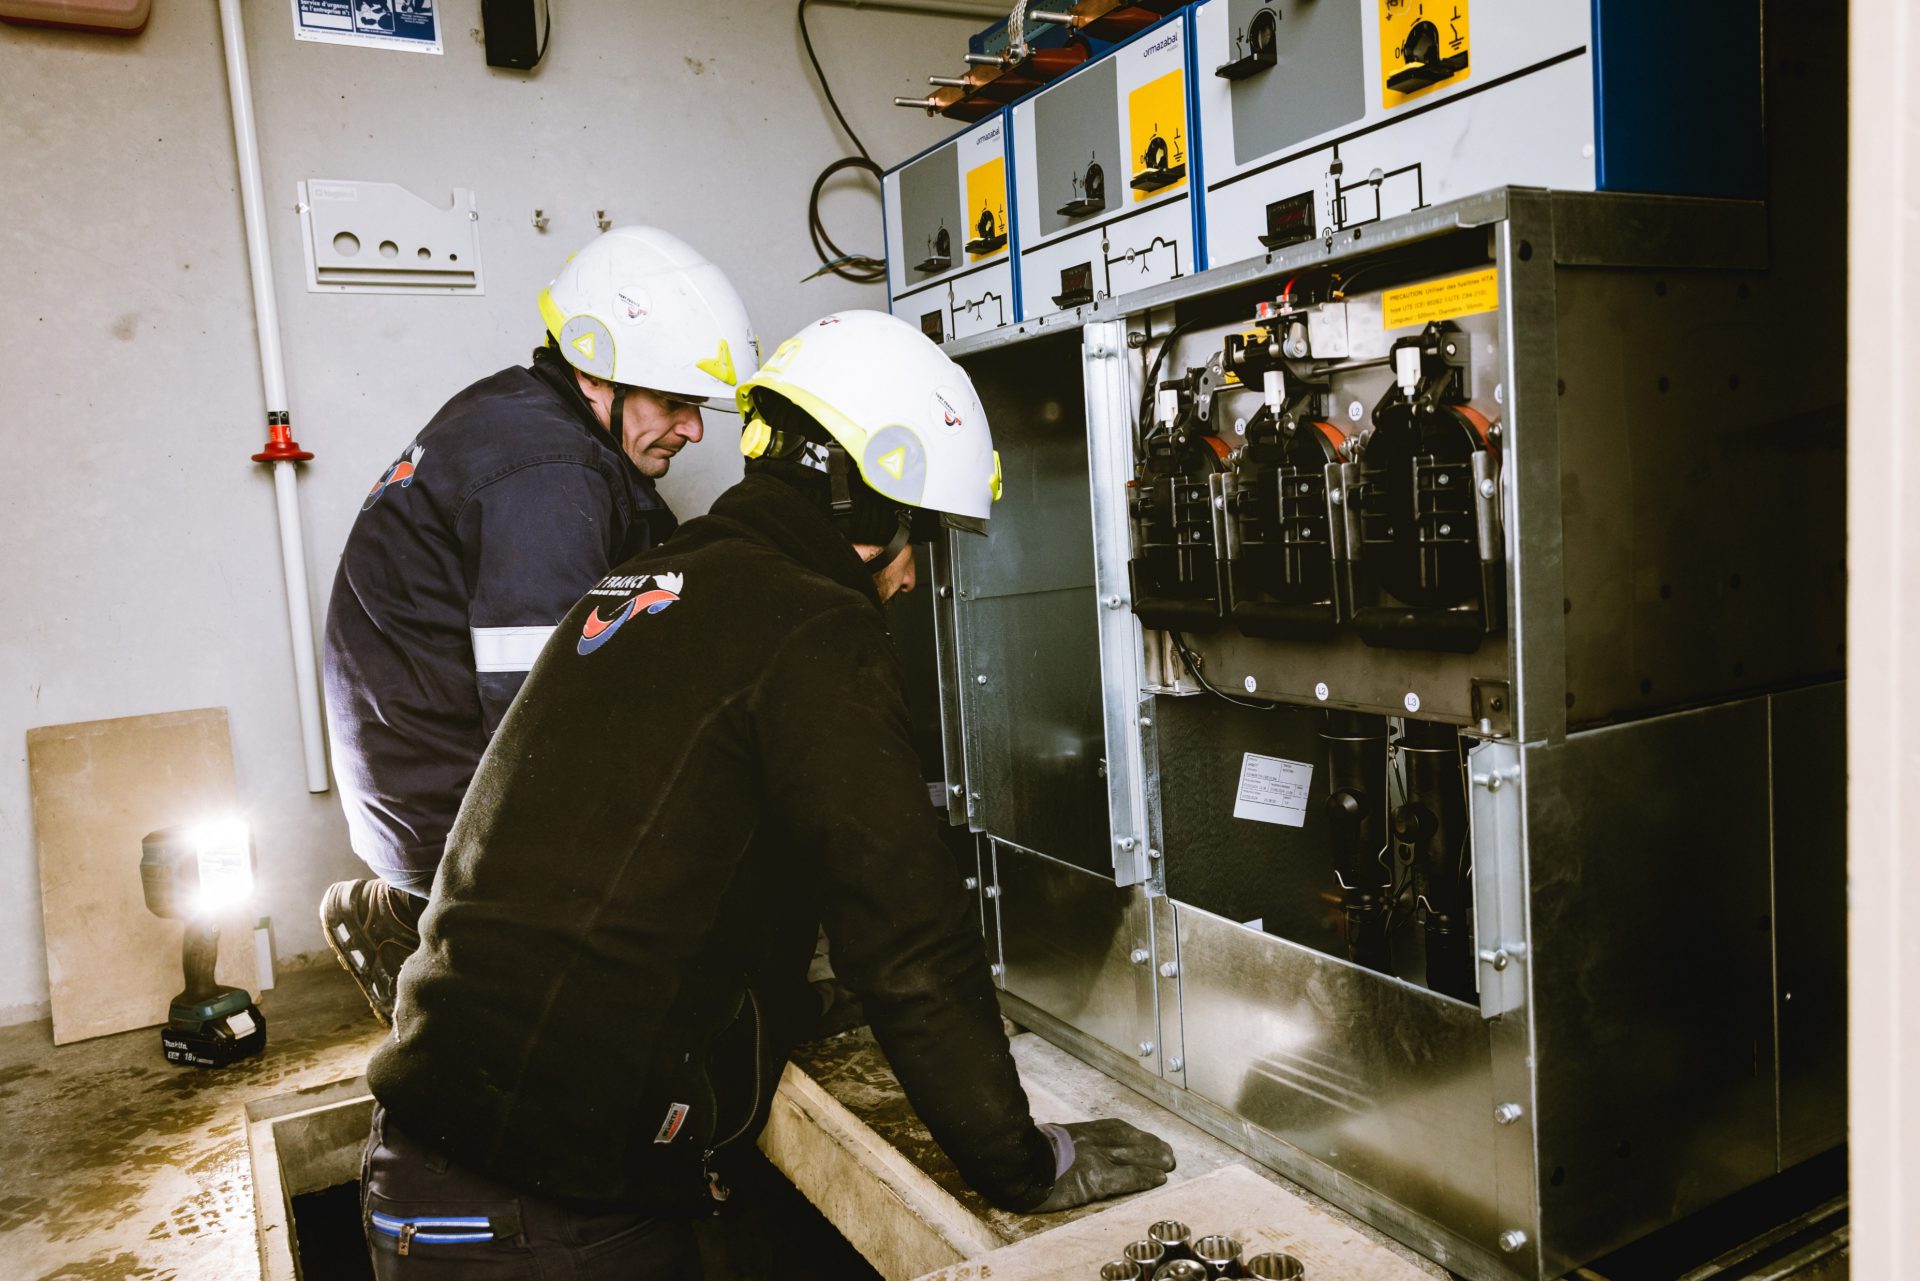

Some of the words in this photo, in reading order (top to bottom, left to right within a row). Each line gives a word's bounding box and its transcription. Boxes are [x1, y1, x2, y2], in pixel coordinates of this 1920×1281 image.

[1143, 32, 1178, 58] ormazabal
[1351, 408, 1360, 417] L2
[1237, 423, 1244, 432] L1
[602, 575, 651, 589] FRANCE
[1247, 680, 1254, 689] L1
[1318, 686, 1326, 696] L2
[1408, 697, 1417, 708] L3
